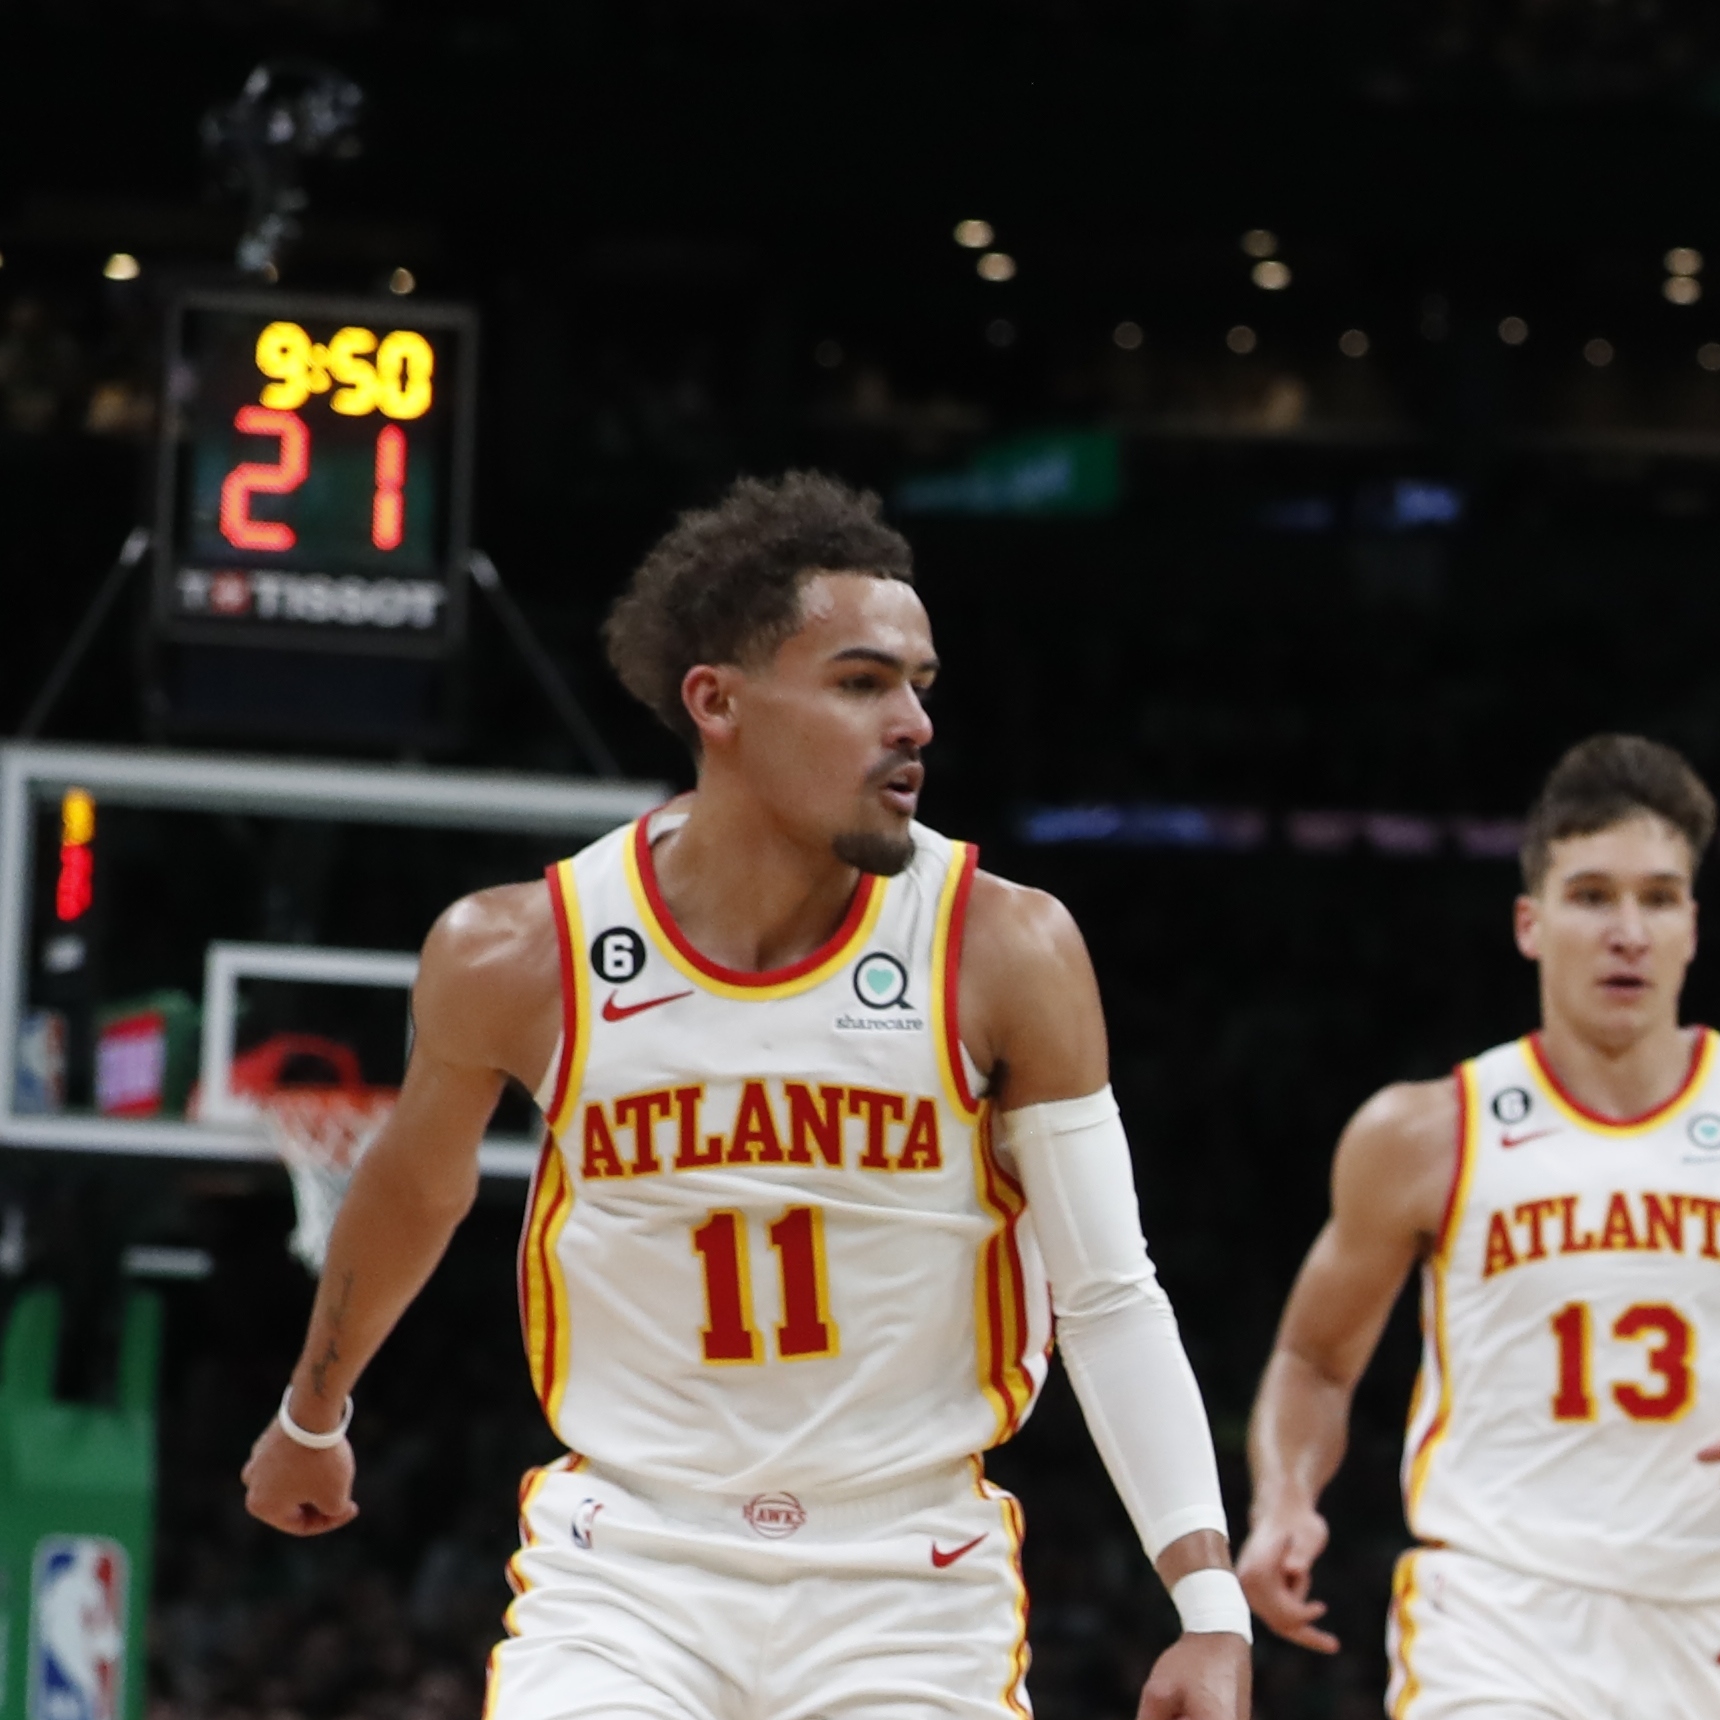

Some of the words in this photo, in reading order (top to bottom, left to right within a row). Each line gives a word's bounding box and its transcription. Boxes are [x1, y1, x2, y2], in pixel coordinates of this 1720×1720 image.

[255, 321, 434, 420] 9:50
[219, 405, 408, 552] 21
[603, 933, 634, 978] 6
[580, 1080, 943, 1181] ATLANTA
[692, 1204, 840, 1367] 11
[1550, 1301, 1697, 1424] 13
